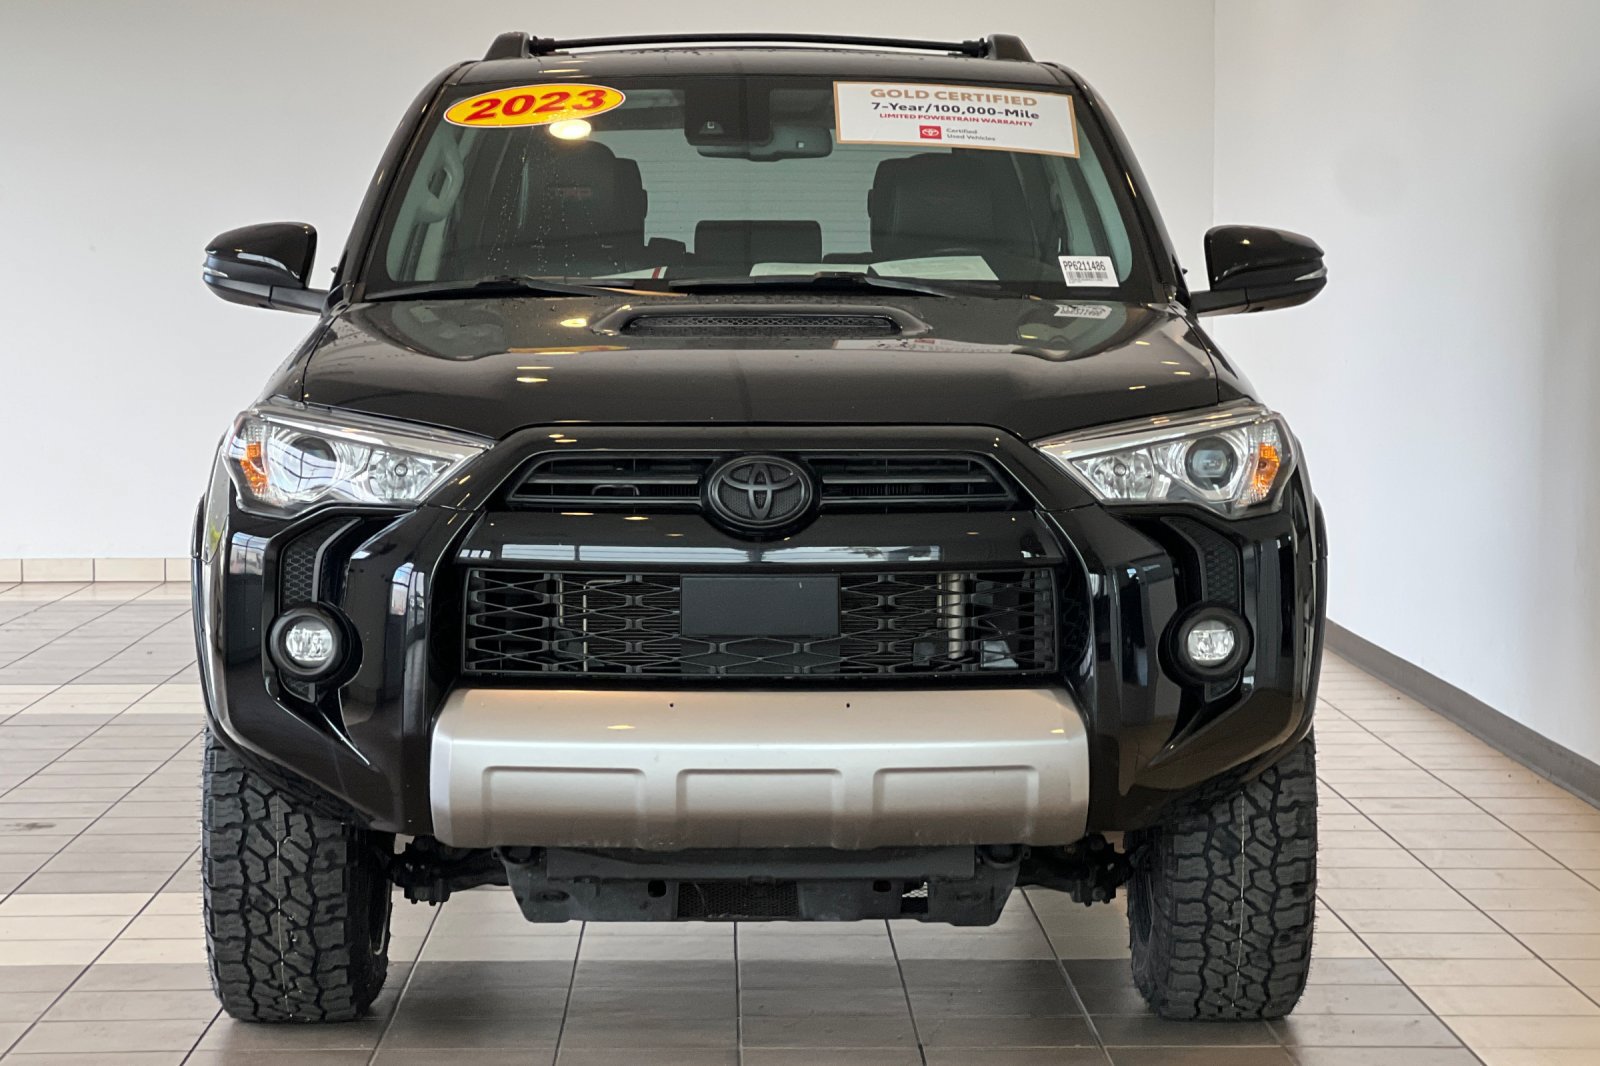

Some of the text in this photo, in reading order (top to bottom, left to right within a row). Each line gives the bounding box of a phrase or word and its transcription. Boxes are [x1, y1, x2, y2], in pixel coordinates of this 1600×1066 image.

[464, 89, 607, 121] 2023
[870, 88, 1038, 106] GOLD CERTIFIED
[871, 102, 1040, 119] 7-Year/100,000-Mile
[918, 114, 980, 123] POWERTRAIN
[981, 117, 1033, 126] WARRANTY
[1062, 260, 1106, 271] PP6211486
